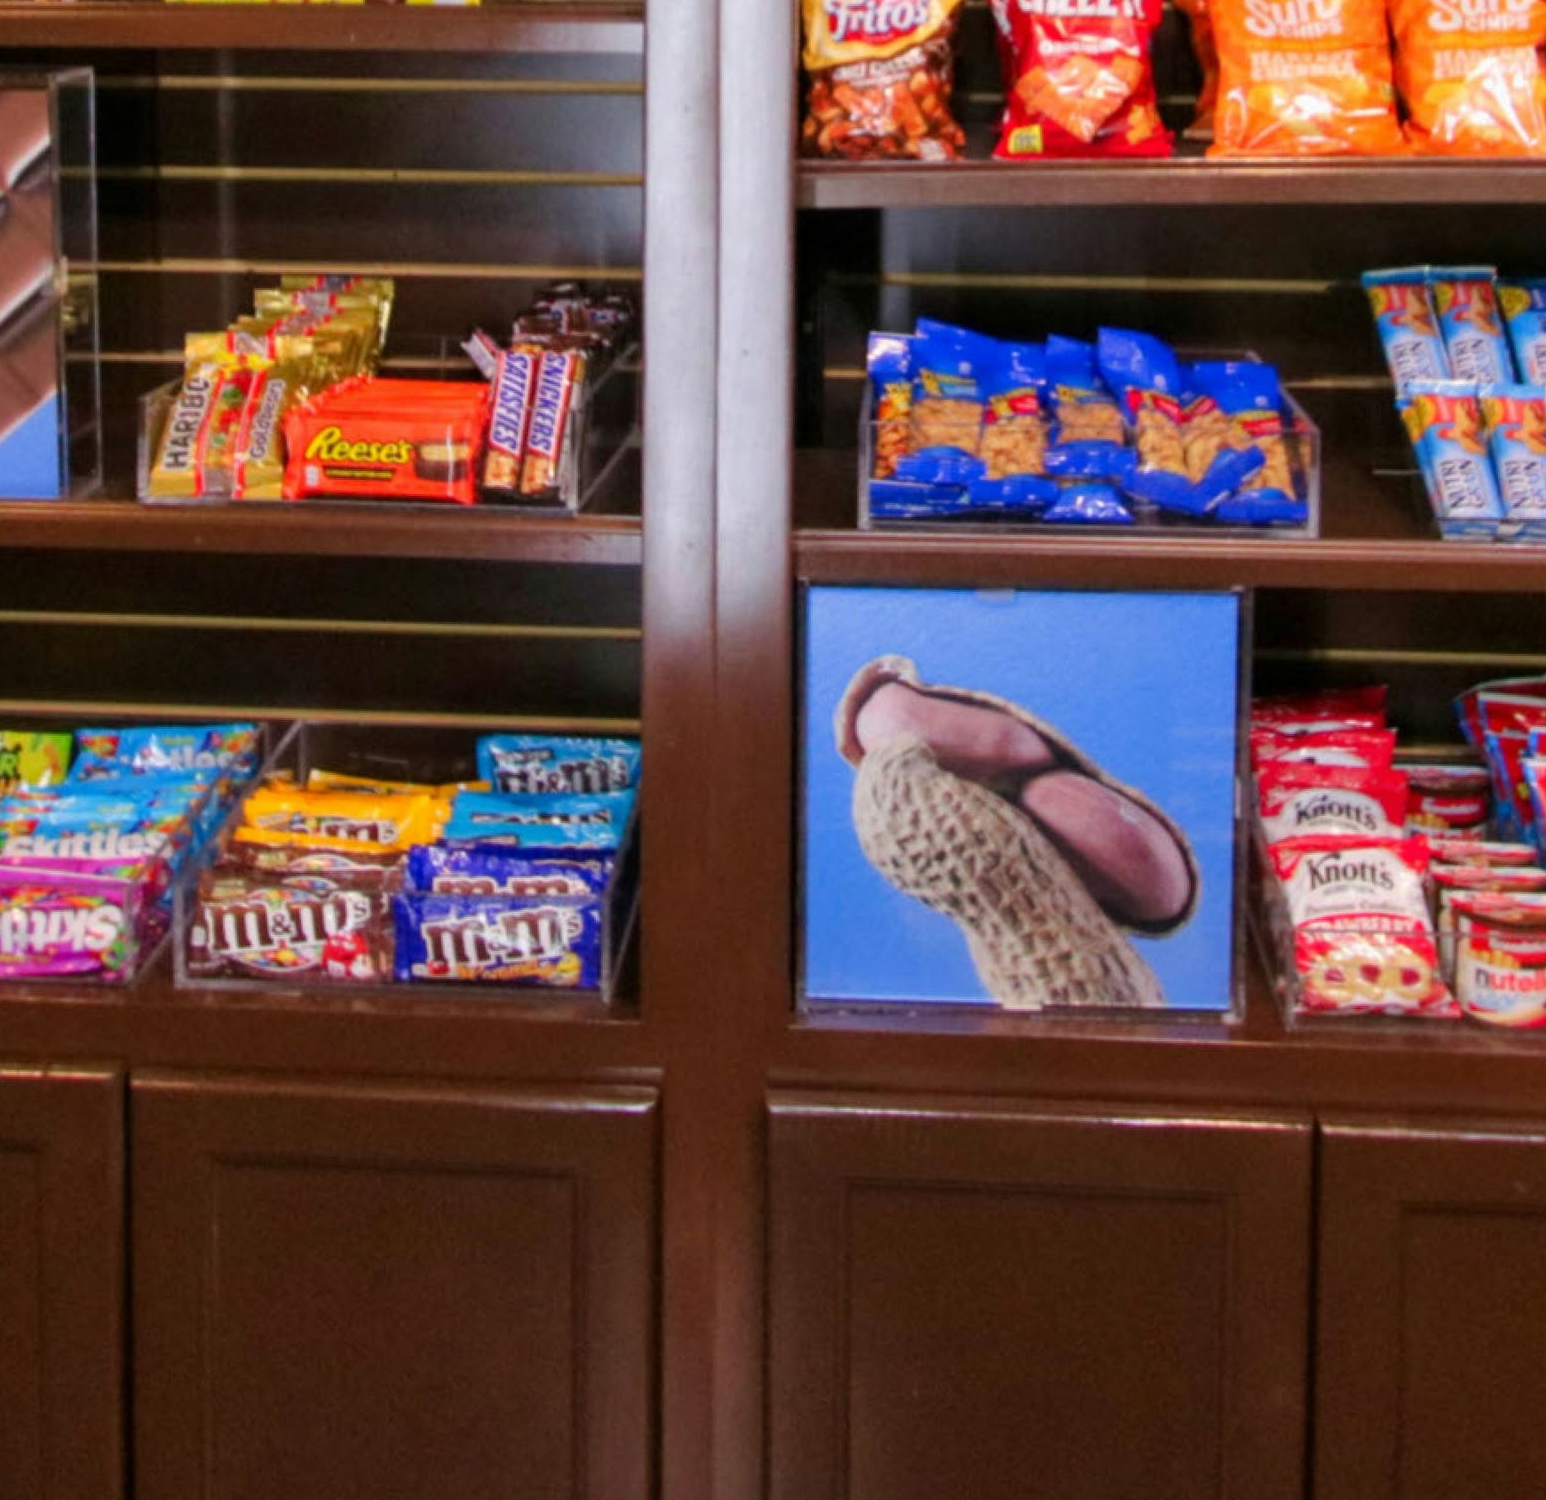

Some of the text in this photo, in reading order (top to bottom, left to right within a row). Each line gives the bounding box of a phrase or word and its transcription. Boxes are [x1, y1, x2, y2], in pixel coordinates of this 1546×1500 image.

[492, 352, 529, 451] SATISFIES
[530, 353, 567, 451] SNICKERS
[306, 428, 414, 464] Reese's
[1295, 795, 1377, 830] Knott's
[1307, 853, 1394, 889] Knott's
